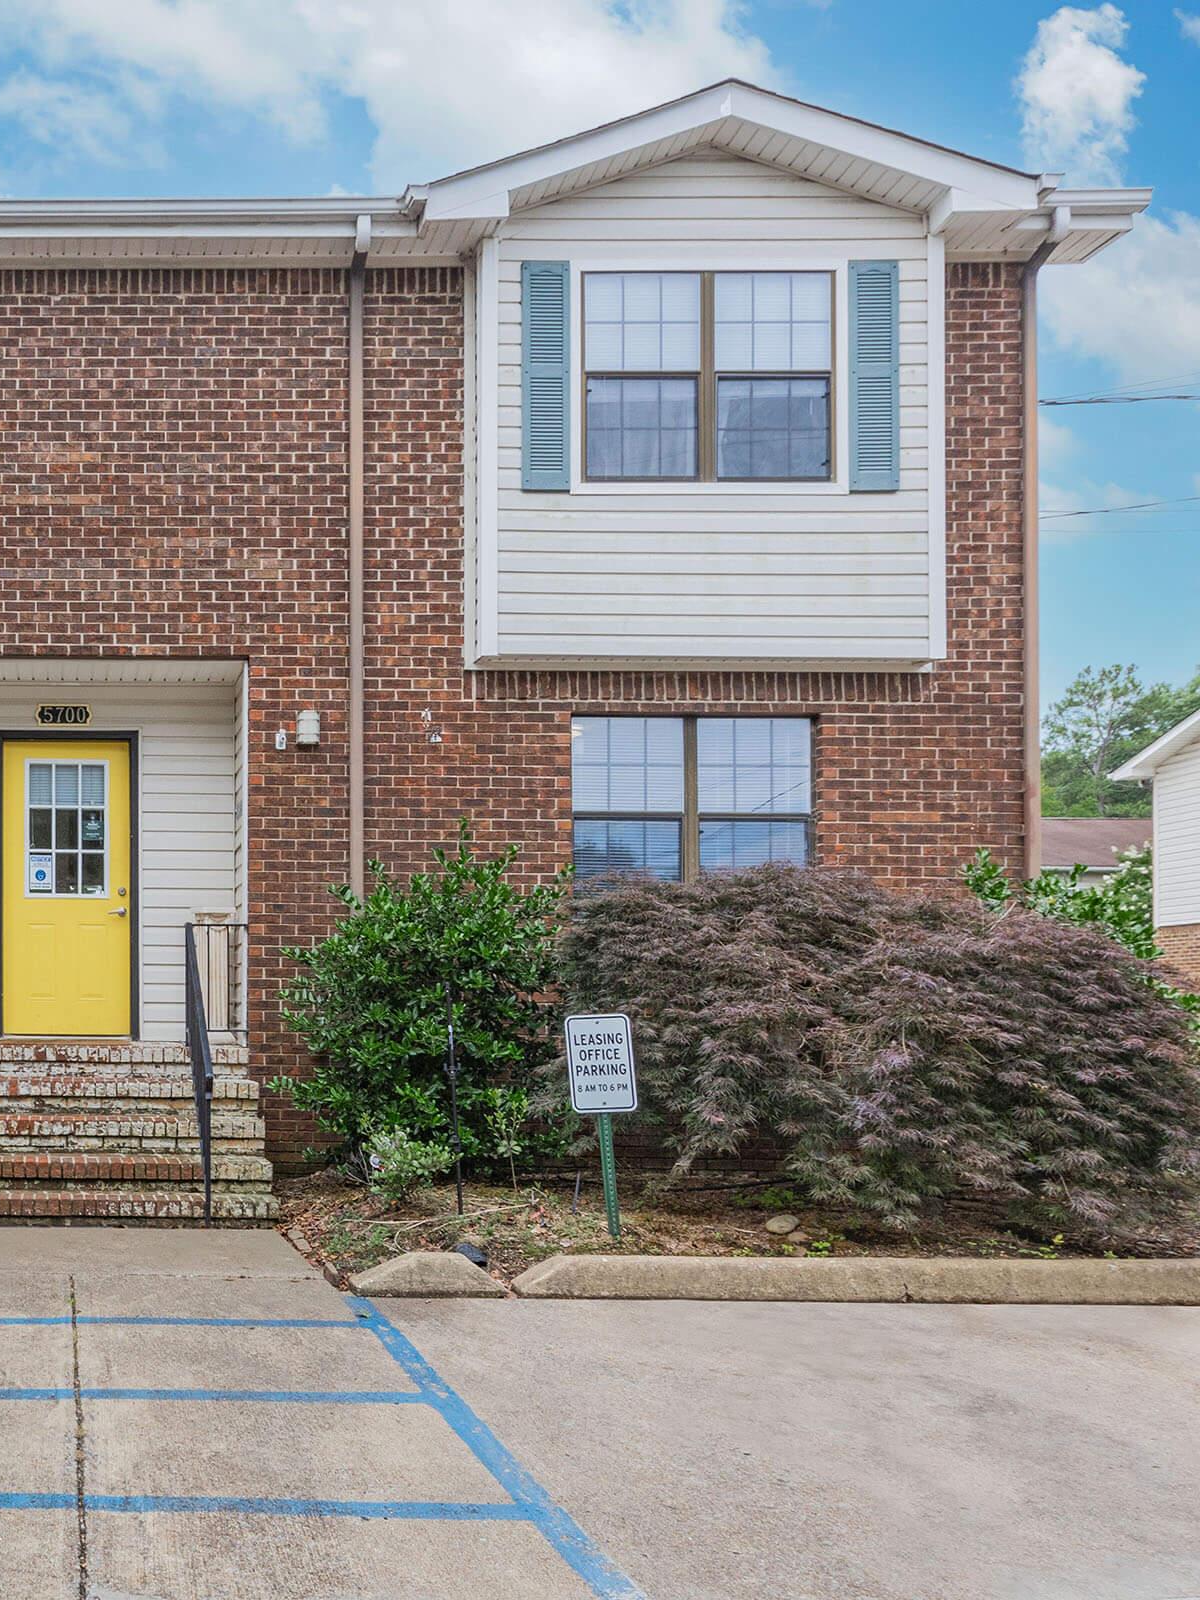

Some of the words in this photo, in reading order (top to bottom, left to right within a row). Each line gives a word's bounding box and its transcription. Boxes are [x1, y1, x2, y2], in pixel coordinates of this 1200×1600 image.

[43, 707, 86, 723] 5700
[574, 1033, 623, 1046] LEASING
[579, 1048, 621, 1061] OFFICE
[576, 1063, 627, 1076] PARKING
[577, 1085, 583, 1093] 8
[585, 1084, 596, 1092] AM
[599, 1083, 608, 1092] TO
[610, 1083, 615, 1091] 6
[617, 1083, 628, 1091] PM
